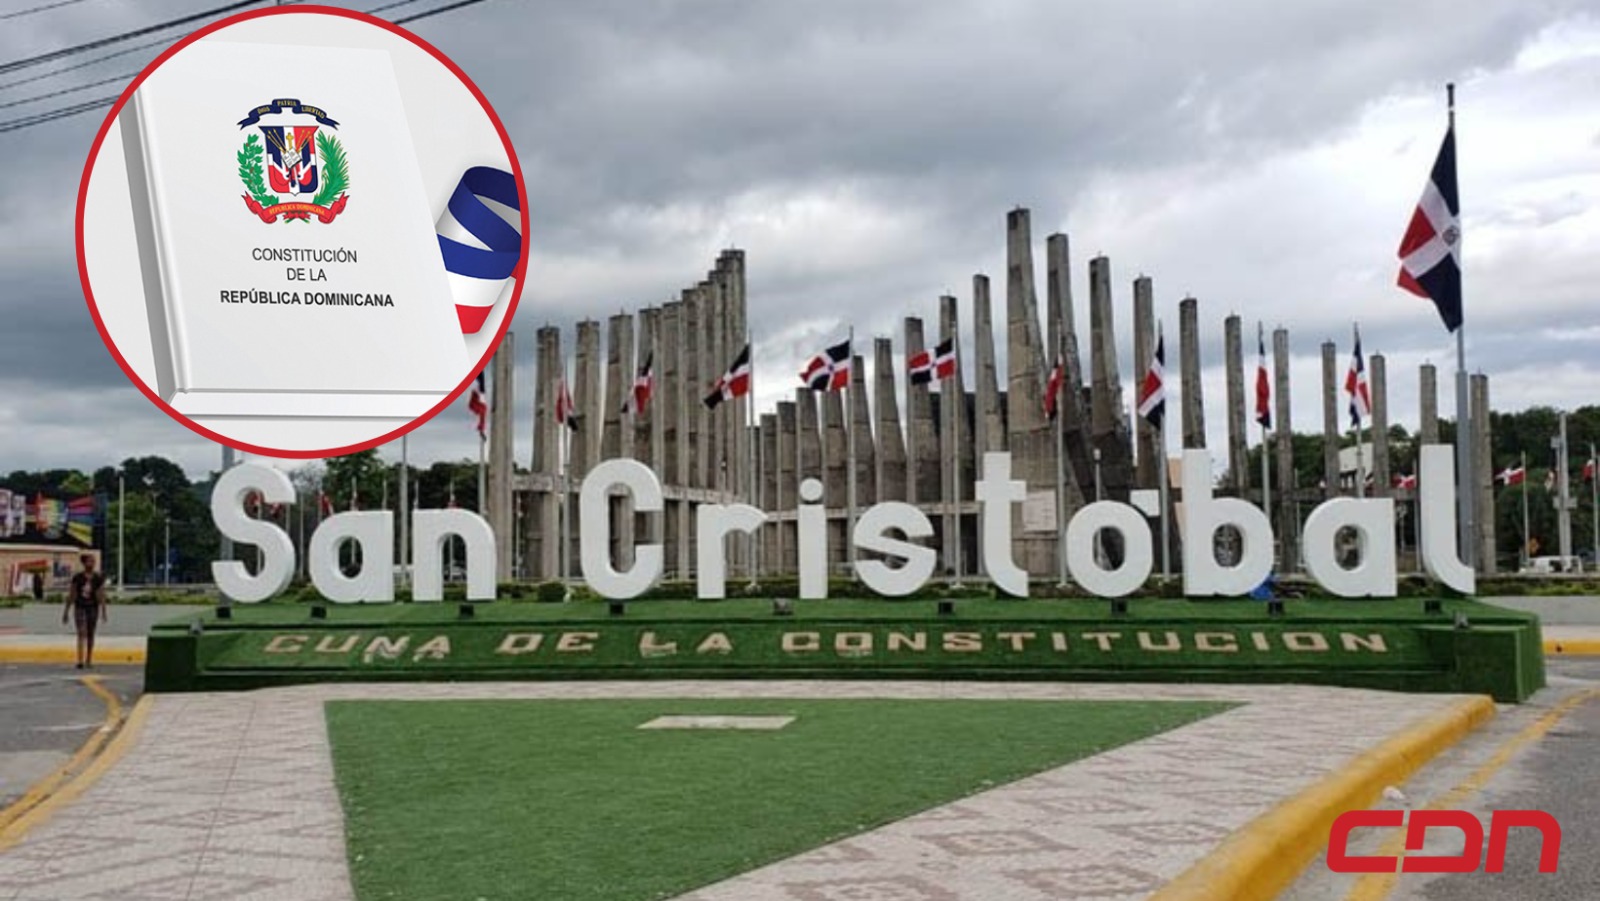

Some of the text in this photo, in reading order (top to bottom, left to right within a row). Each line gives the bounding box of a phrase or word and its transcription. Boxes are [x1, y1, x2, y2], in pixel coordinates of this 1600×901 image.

[210, 462, 498, 604] San
[263, 630, 1390, 661] CUNA DE LA CONSTITUCION
